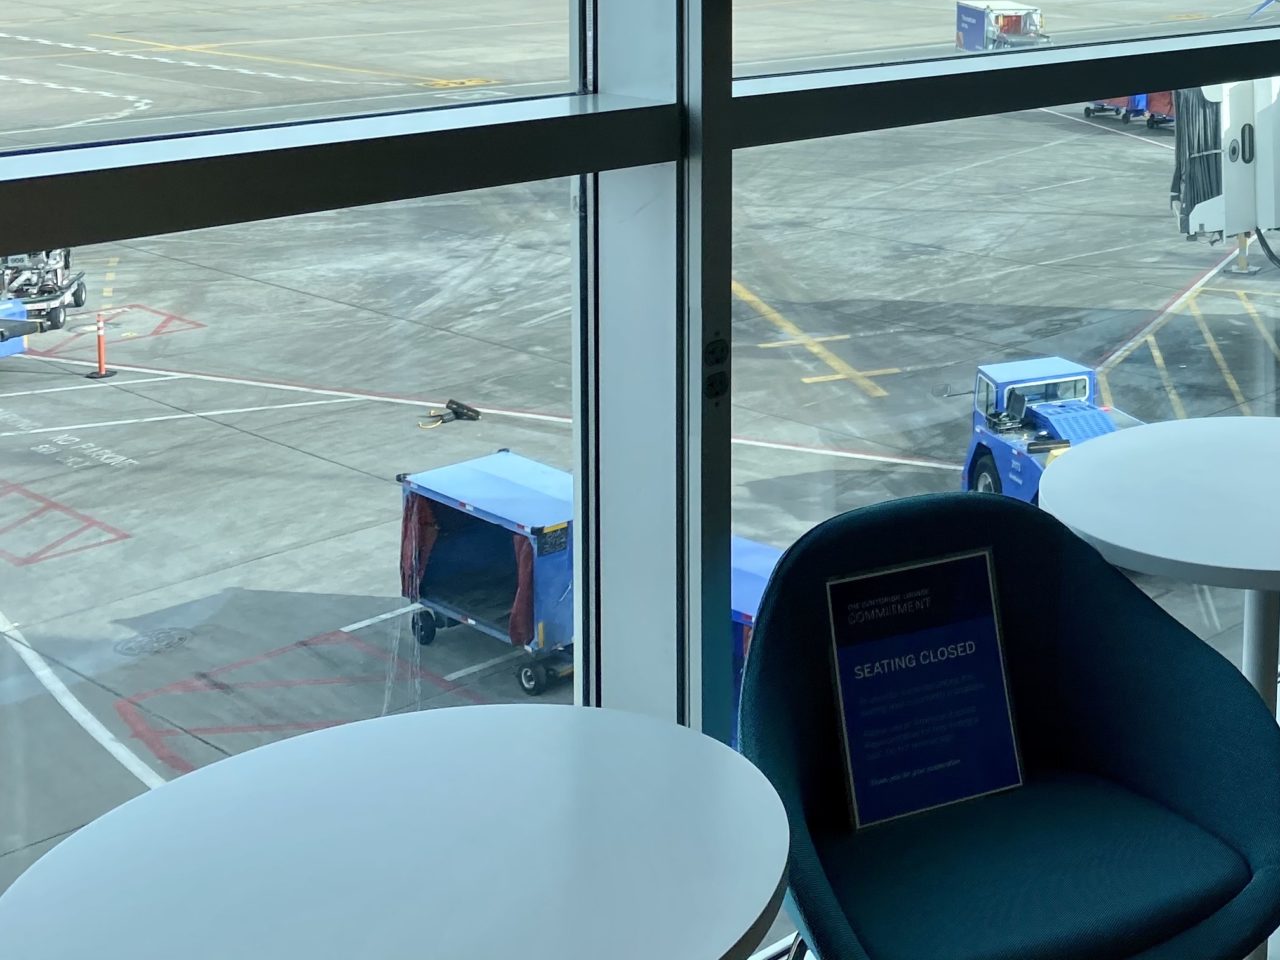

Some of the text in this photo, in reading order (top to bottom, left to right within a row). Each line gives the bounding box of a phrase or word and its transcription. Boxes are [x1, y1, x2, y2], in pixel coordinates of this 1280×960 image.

[847, 596, 932, 626] COMMITMENT
[853, 640, 977, 680] SEATING CLOSED
